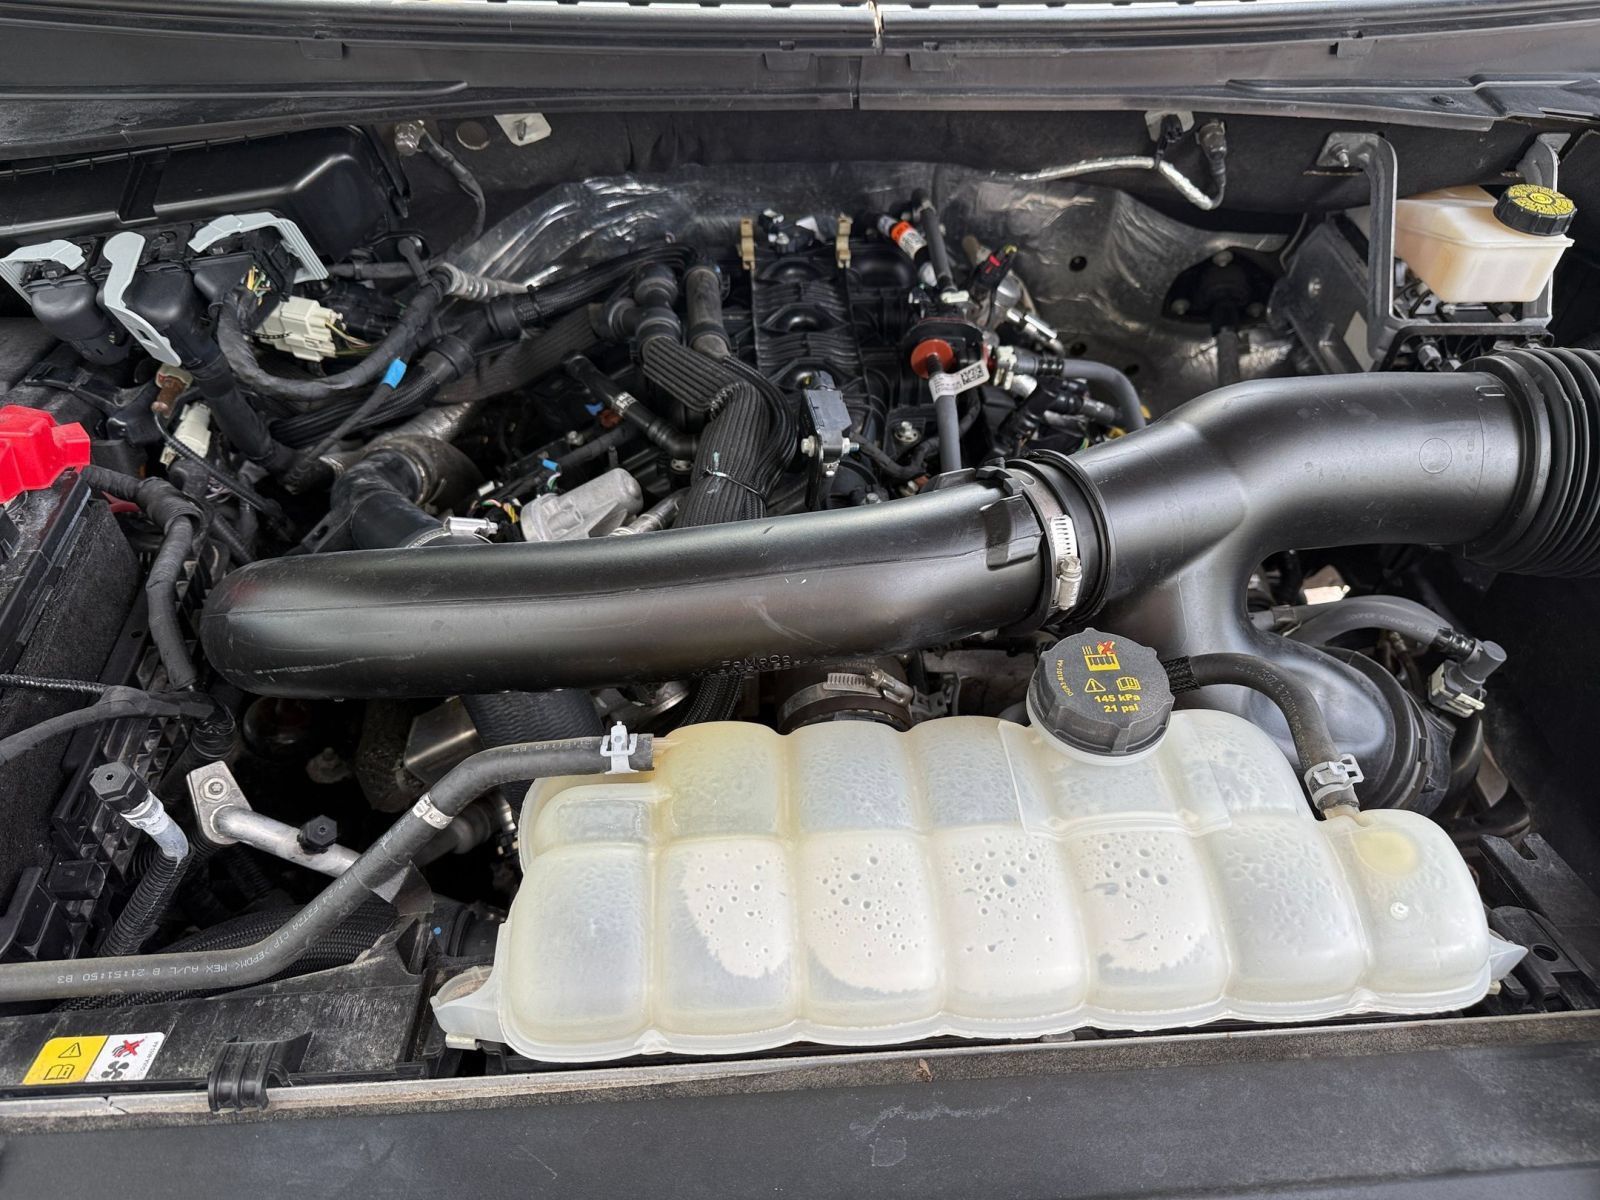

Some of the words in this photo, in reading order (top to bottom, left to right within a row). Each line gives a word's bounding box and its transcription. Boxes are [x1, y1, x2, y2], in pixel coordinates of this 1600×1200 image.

[1094, 694, 1116, 703] 145
[1118, 693, 1142, 702] kPa
[1103, 705, 1117, 713] 21
[1121, 704, 1139, 714] psi
[205, 963, 228, 974] MEX
[57, 974, 73, 984] B3
[82, 968, 145, 982] 21:51:50
